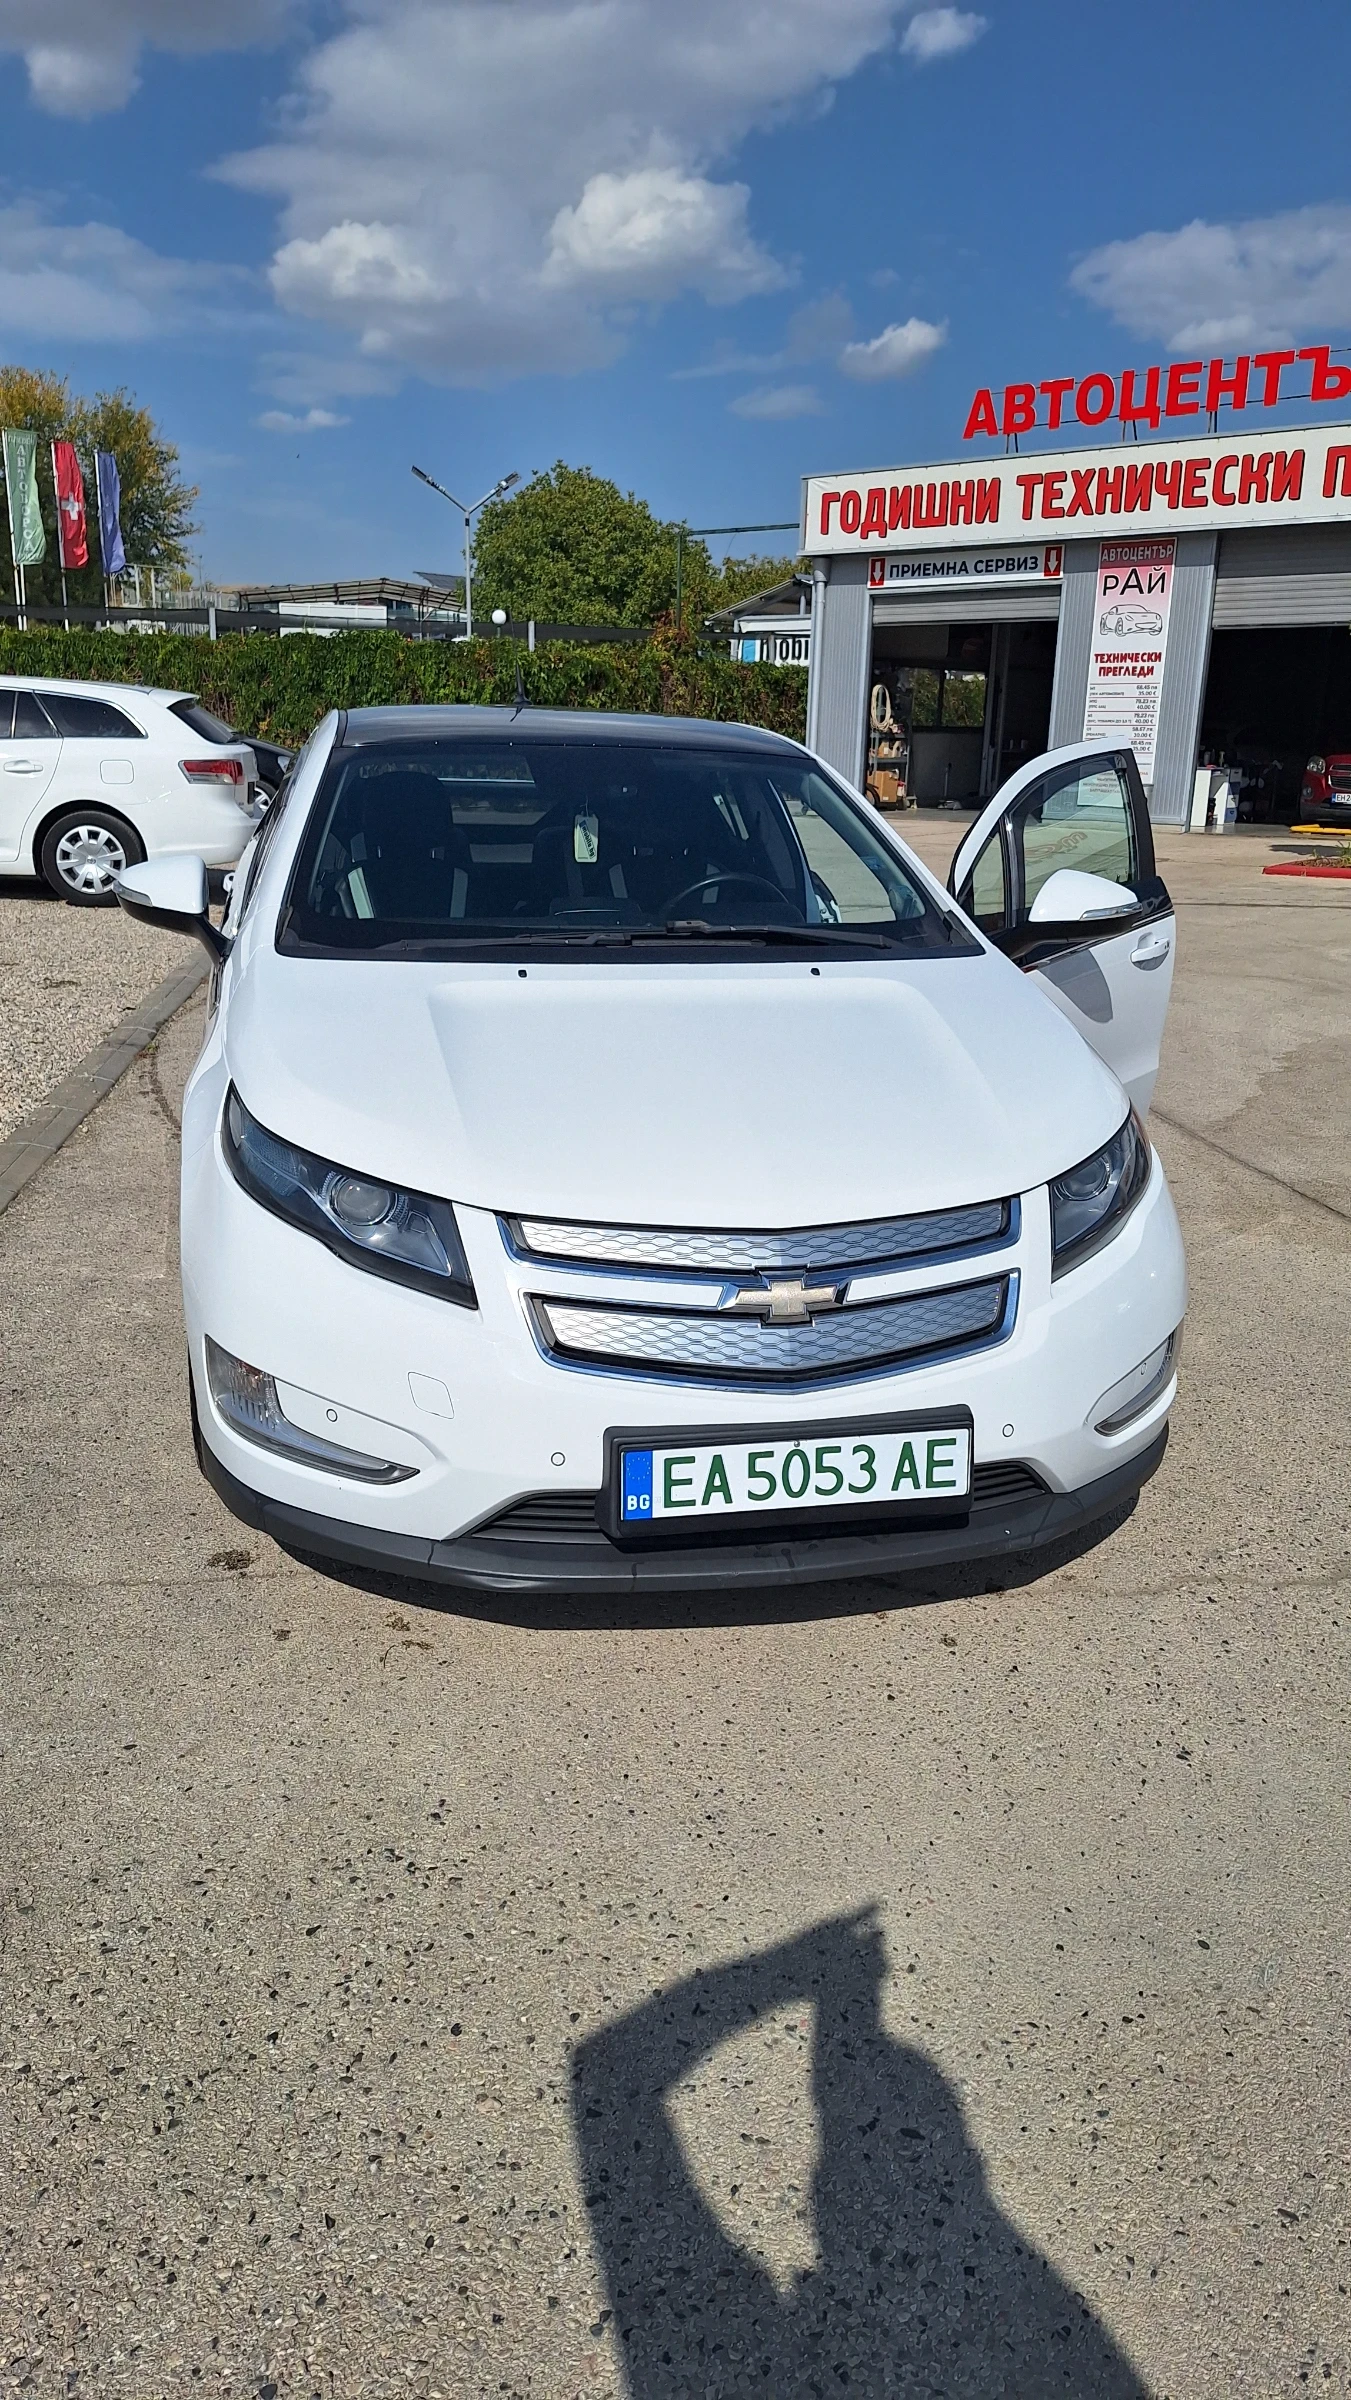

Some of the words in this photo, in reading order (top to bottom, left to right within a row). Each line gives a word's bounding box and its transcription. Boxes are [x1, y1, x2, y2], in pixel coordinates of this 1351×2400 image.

[962, 345, 1351, 440] АВТОЦЕНТЪ
[820, 477, 1001, 540] ГОДИШНИ
[1016, 449, 1306, 521] ТЕХНИЧЕСКИ
[1101, 544, 1174, 562] АВТОЦЕНТЪР
[889, 560, 969, 578] ПРИЕМНА
[973, 556, 1039, 574] СЕРВИЗ
[1103, 566, 1166, 596] РАЙ
[1094, 652, 1162, 664] ТЕХНИЧЕСКИ
[1098, 665, 1155, 678] ПРЕГЛЕДИ
[664, 1454, 733, 1509] EA
[748, 1444, 877, 1501] 5053
[891, 1438, 957, 1492] AE
[626, 1494, 650, 1511] BG
